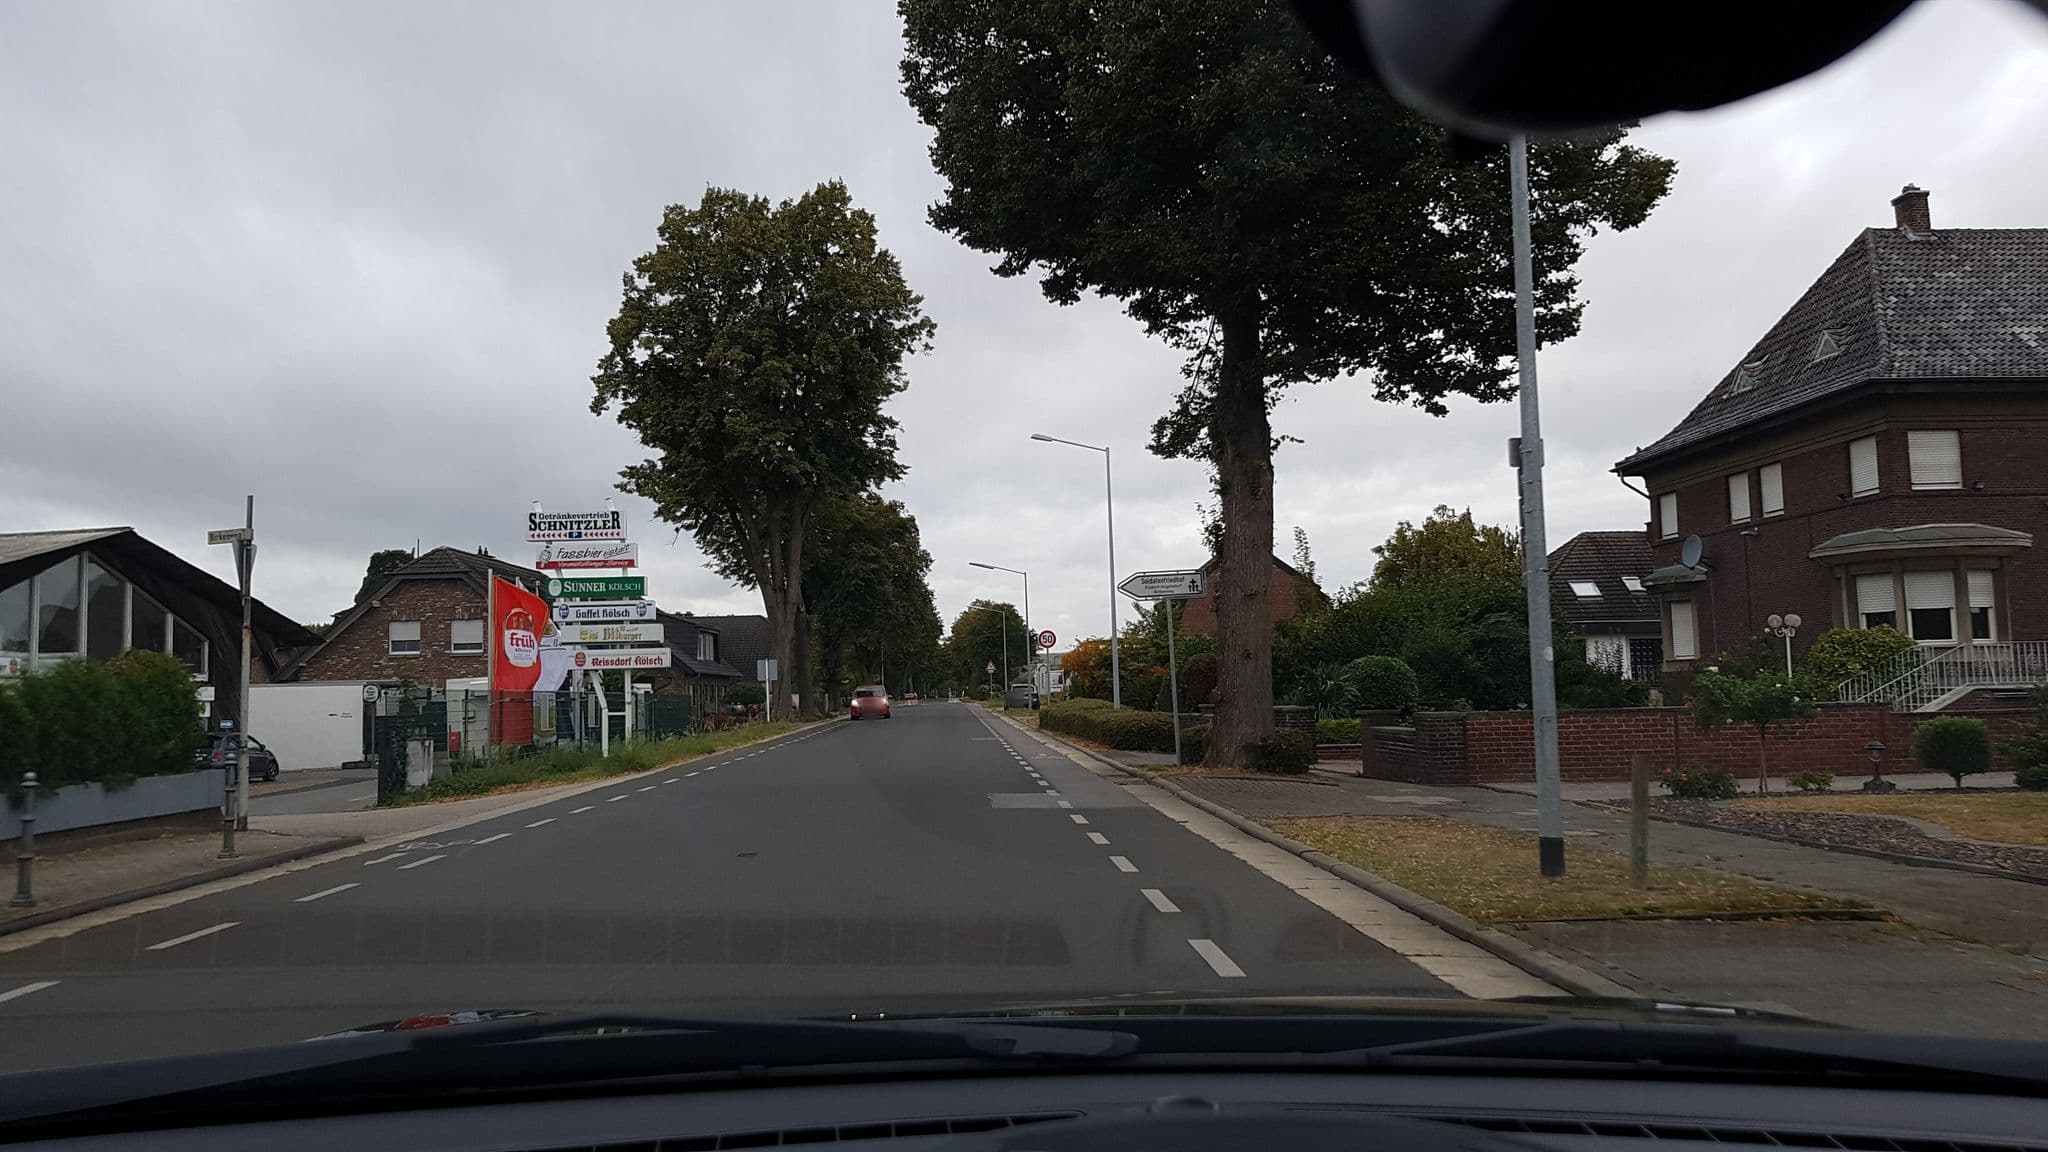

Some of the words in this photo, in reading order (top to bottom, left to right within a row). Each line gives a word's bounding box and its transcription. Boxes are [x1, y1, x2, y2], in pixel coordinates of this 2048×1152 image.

[529, 511, 621, 531] SCHNITZLER
[539, 512, 609, 520] Getränkevertrieb
[556, 547, 603, 559] Fassbier
[575, 609, 600, 619] Gaffel
[602, 608, 630, 618] Kölsch
[1042, 634, 1053, 644] 50
[591, 656, 632, 667] Reissdorf
[634, 655, 664, 666] Kölsch
